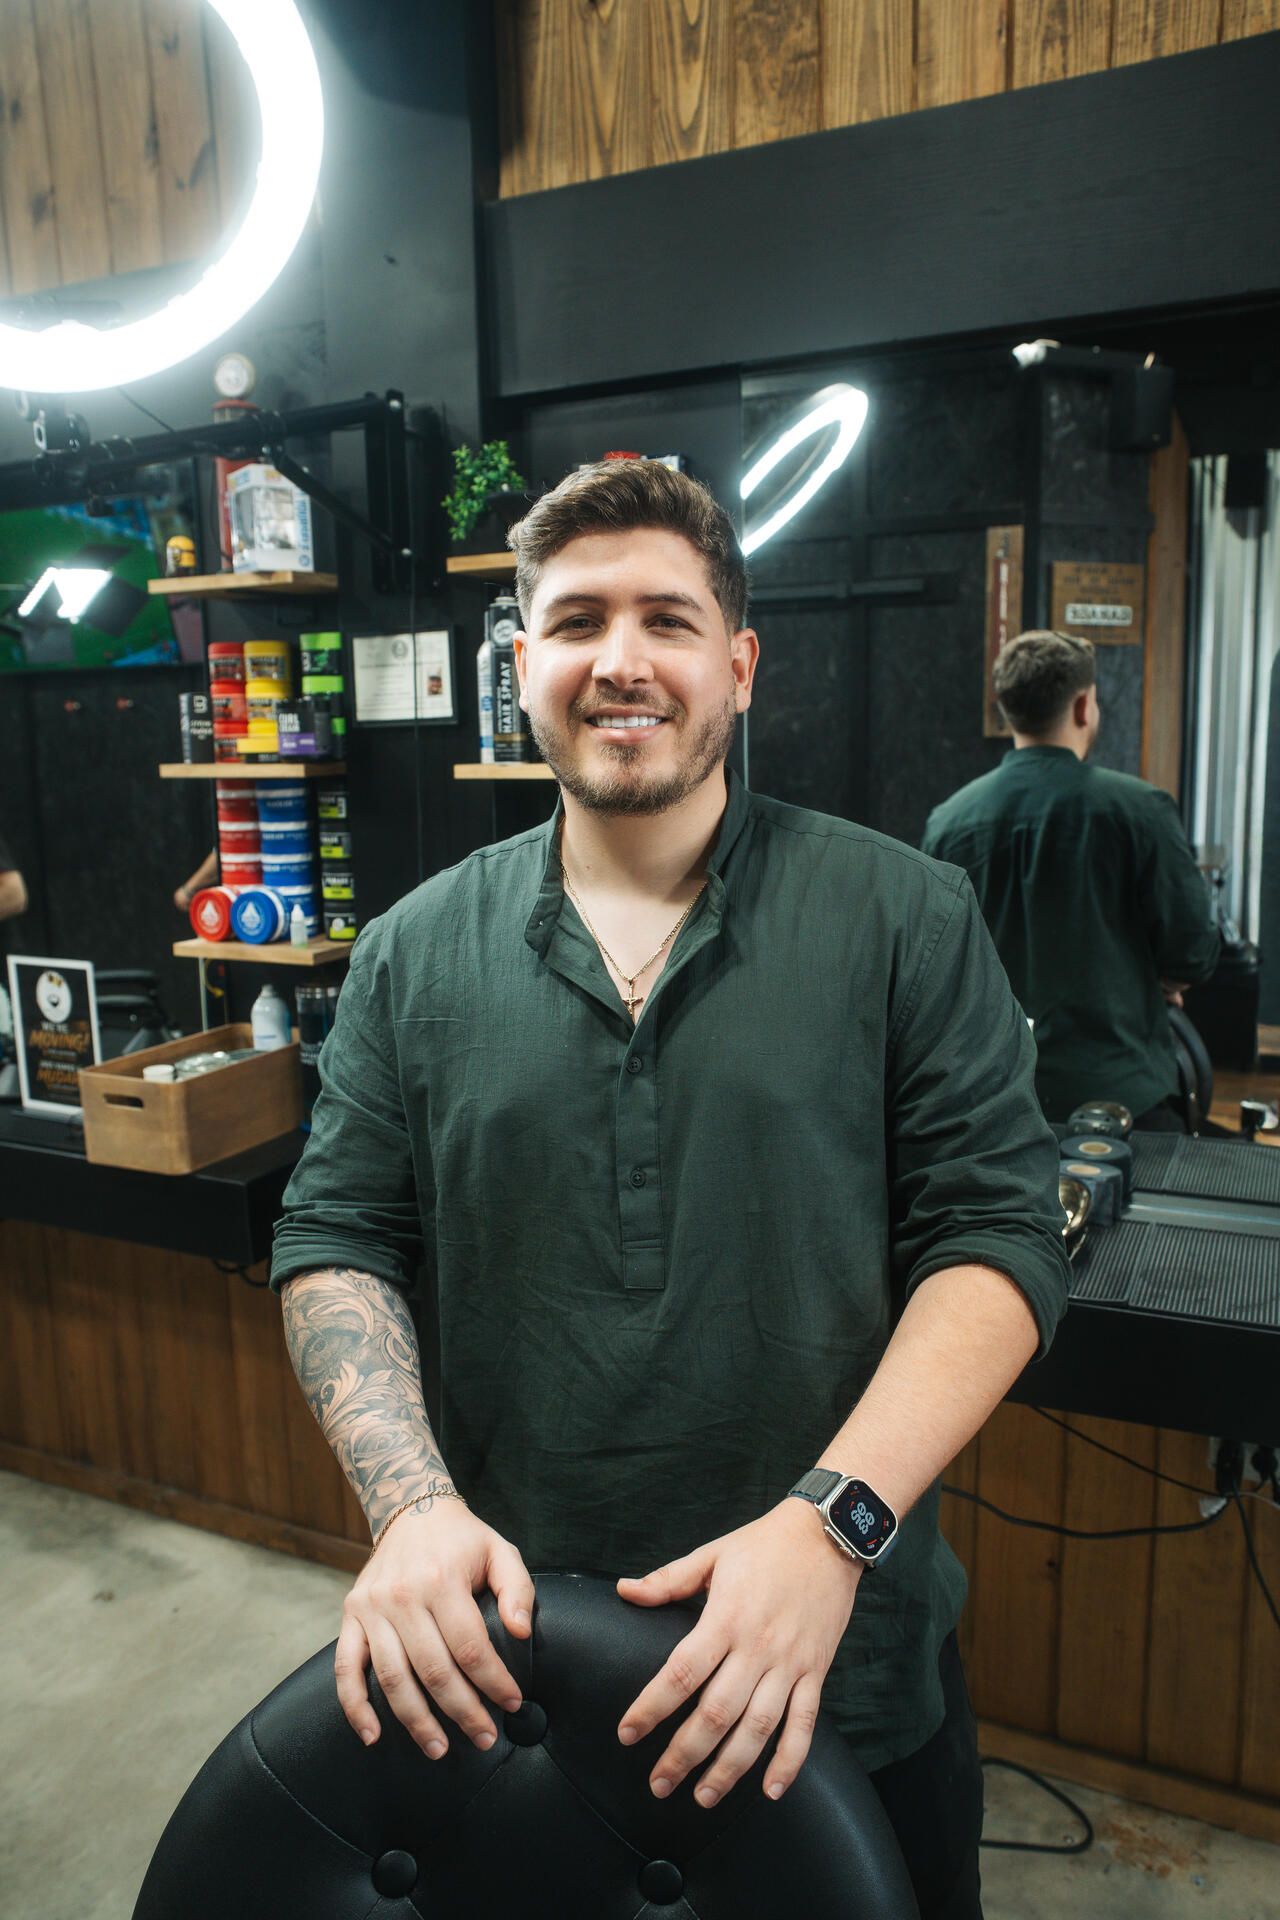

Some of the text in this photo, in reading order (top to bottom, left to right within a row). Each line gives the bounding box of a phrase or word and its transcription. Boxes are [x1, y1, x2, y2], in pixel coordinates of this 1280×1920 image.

[500, 661, 513, 734] HAIR SPRAY
[29, 1030, 90, 1052] MOVING!
